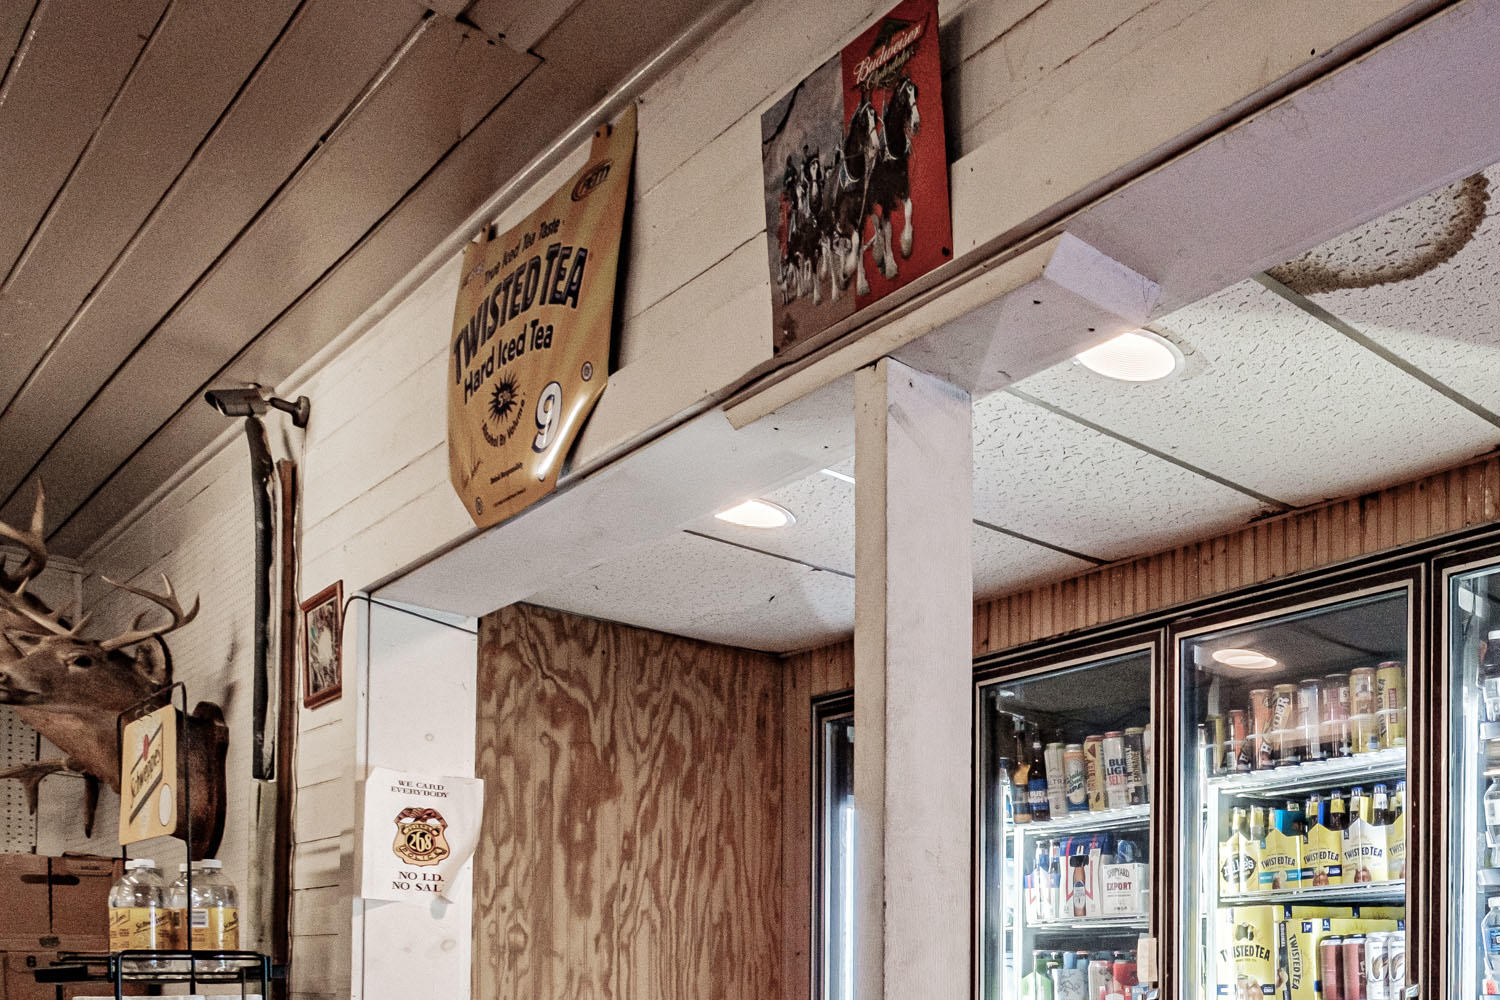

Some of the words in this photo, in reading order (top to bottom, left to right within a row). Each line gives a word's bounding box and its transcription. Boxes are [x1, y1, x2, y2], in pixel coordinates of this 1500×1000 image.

[854, 24, 920, 82] Budweiser
[453, 256, 540, 384] TWISTED
[539, 242, 587, 308] TEA
[464, 346, 497, 403] Hard
[497, 330, 526, 369] Iced
[529, 322, 554, 350] Tea
[531, 381, 562, 453] 9
[391, 787, 449, 798] EVERYBODY
[398, 780, 413, 788] WE
[416, 782, 445, 790] CARD
[410, 833, 432, 852] 268
[1304, 851, 1327, 863] TWISTED
[1327, 851, 1340, 862] TEA
[1344, 847, 1370, 860] TWISTED
[1370, 846, 1383, 858] TEA
[1261, 857, 1285, 868] TWISTED
[1285, 857, 1296, 868] TEA
[398, 871, 418, 880] NO
[392, 881, 411, 891] NO
[416, 883, 442, 893] SAL
[1106, 882, 1133, 892] EXPORT
[1255, 945, 1271, 962] TEA
[1288, 934, 1301, 974] TWISTED
[1291, 973, 1301, 991] TEA
